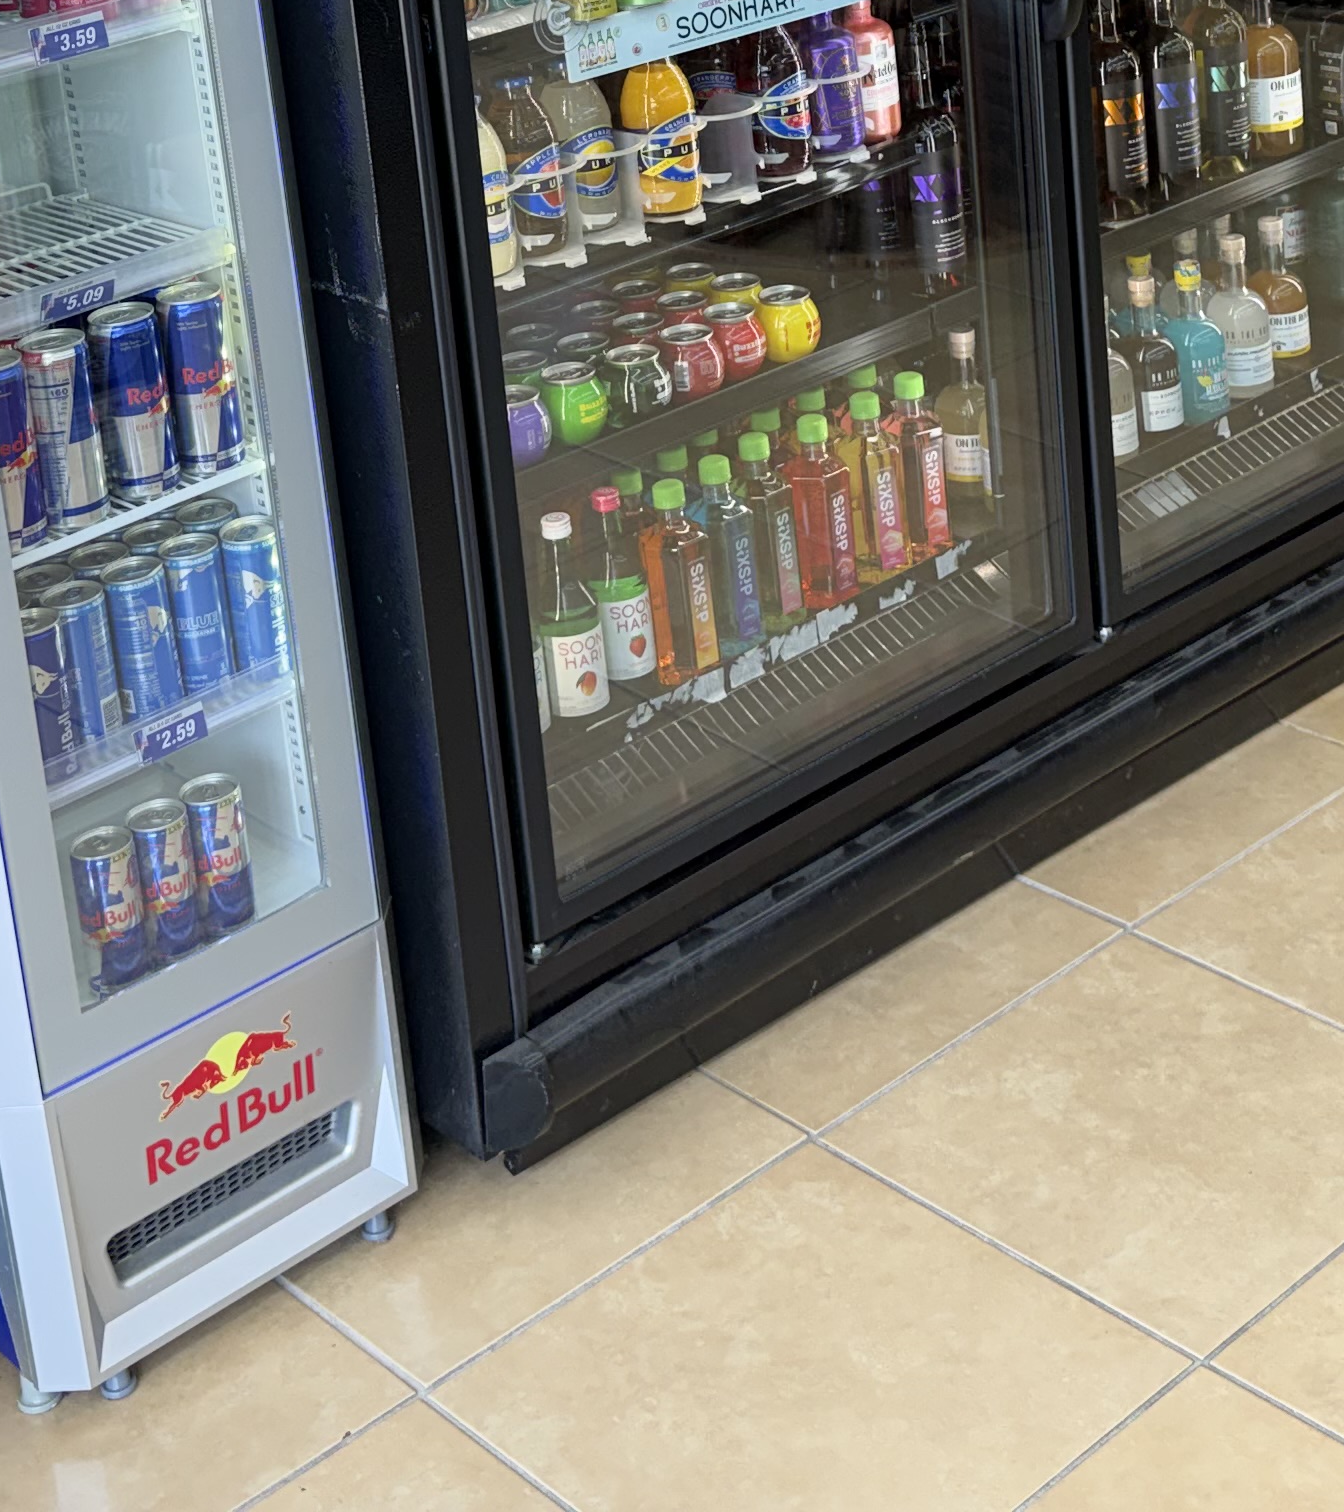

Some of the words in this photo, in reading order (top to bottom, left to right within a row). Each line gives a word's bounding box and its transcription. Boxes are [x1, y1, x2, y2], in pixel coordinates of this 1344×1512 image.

[54, 26, 97, 52] $3.59
[62, 285, 105, 311] $5.09
[181, 365, 220, 386] Red
[127, 380, 165, 407] Red
[609, 596, 650, 621] SOON
[616, 612, 649, 634] HAR
[557, 632, 602, 657] SOON
[564, 649, 600, 671] HAR
[155, 717, 197, 750] $2.59
[210, 845, 243, 871] Bull
[159, 871, 192, 899] Bull
[103, 899, 138, 928] Bull
[144, 1100, 233, 1187] Red
[236, 1052, 319, 1134] Bull
